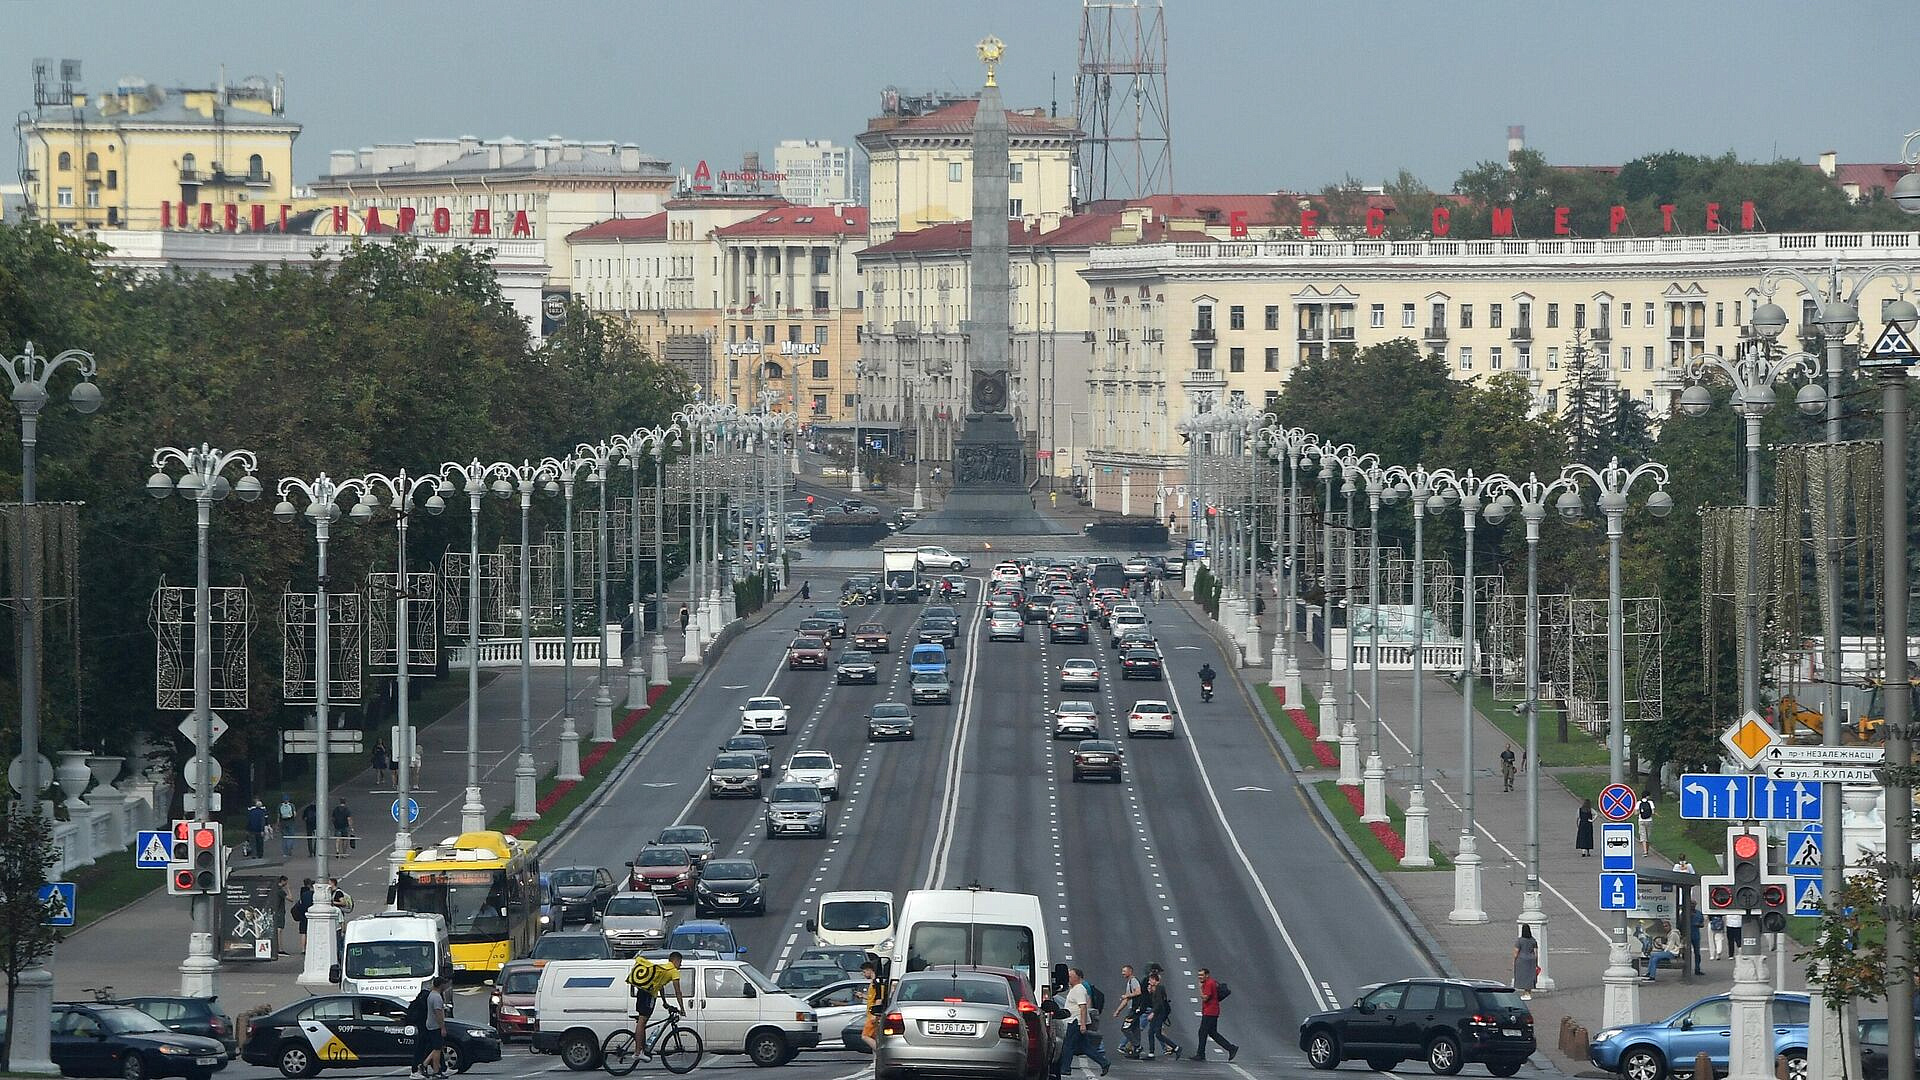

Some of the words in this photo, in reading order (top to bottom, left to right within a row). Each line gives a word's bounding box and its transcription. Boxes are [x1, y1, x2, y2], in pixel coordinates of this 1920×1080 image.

[333, 206, 531, 236] НАРОДА
[1788, 751, 1804, 759] пр-т
[1806, 750, 1874, 759] НЕЗАЛЕЖНАСЦІ
[1790, 771, 1809, 780] вул.
[1656, 904, 1663, 912] 6
[337, 1025, 354, 1033] 9097
[328, 1042, 349, 1061] Go
